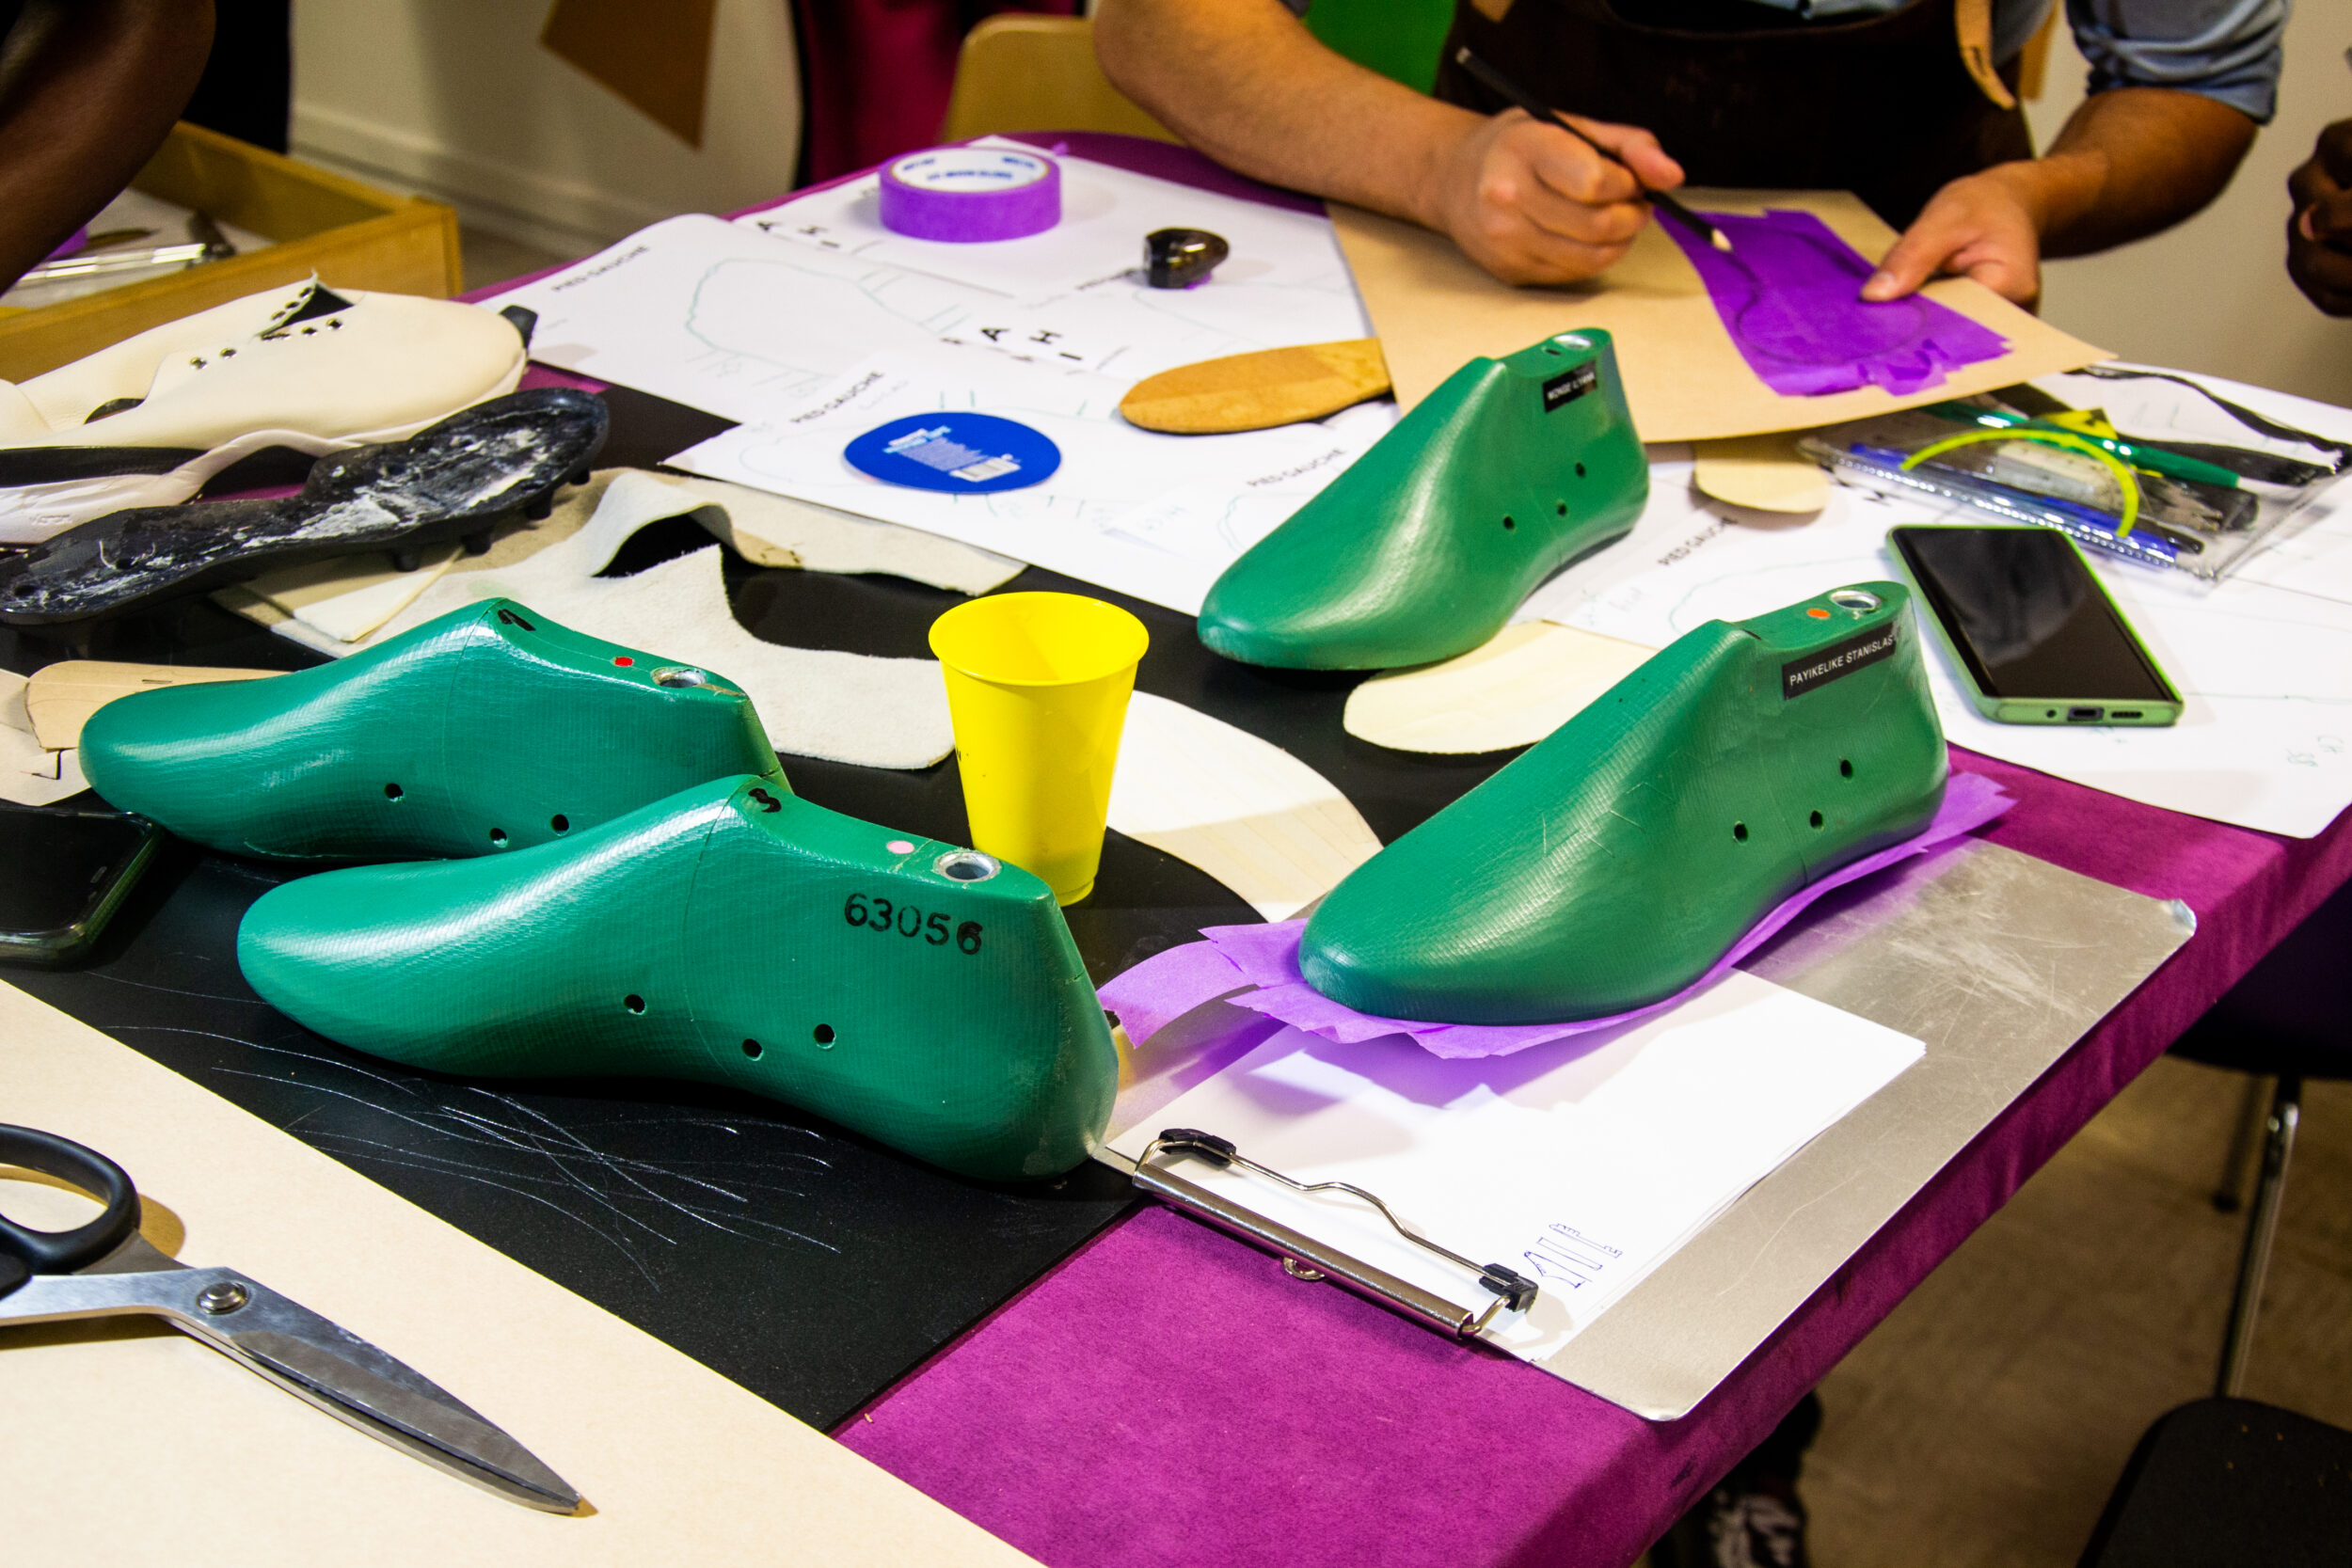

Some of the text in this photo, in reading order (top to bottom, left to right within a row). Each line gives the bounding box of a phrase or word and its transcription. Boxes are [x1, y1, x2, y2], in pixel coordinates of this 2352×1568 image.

[1788, 634, 1894, 687] PAYIKELIKE STANISLAS
[843, 892, 984, 956] 63056
